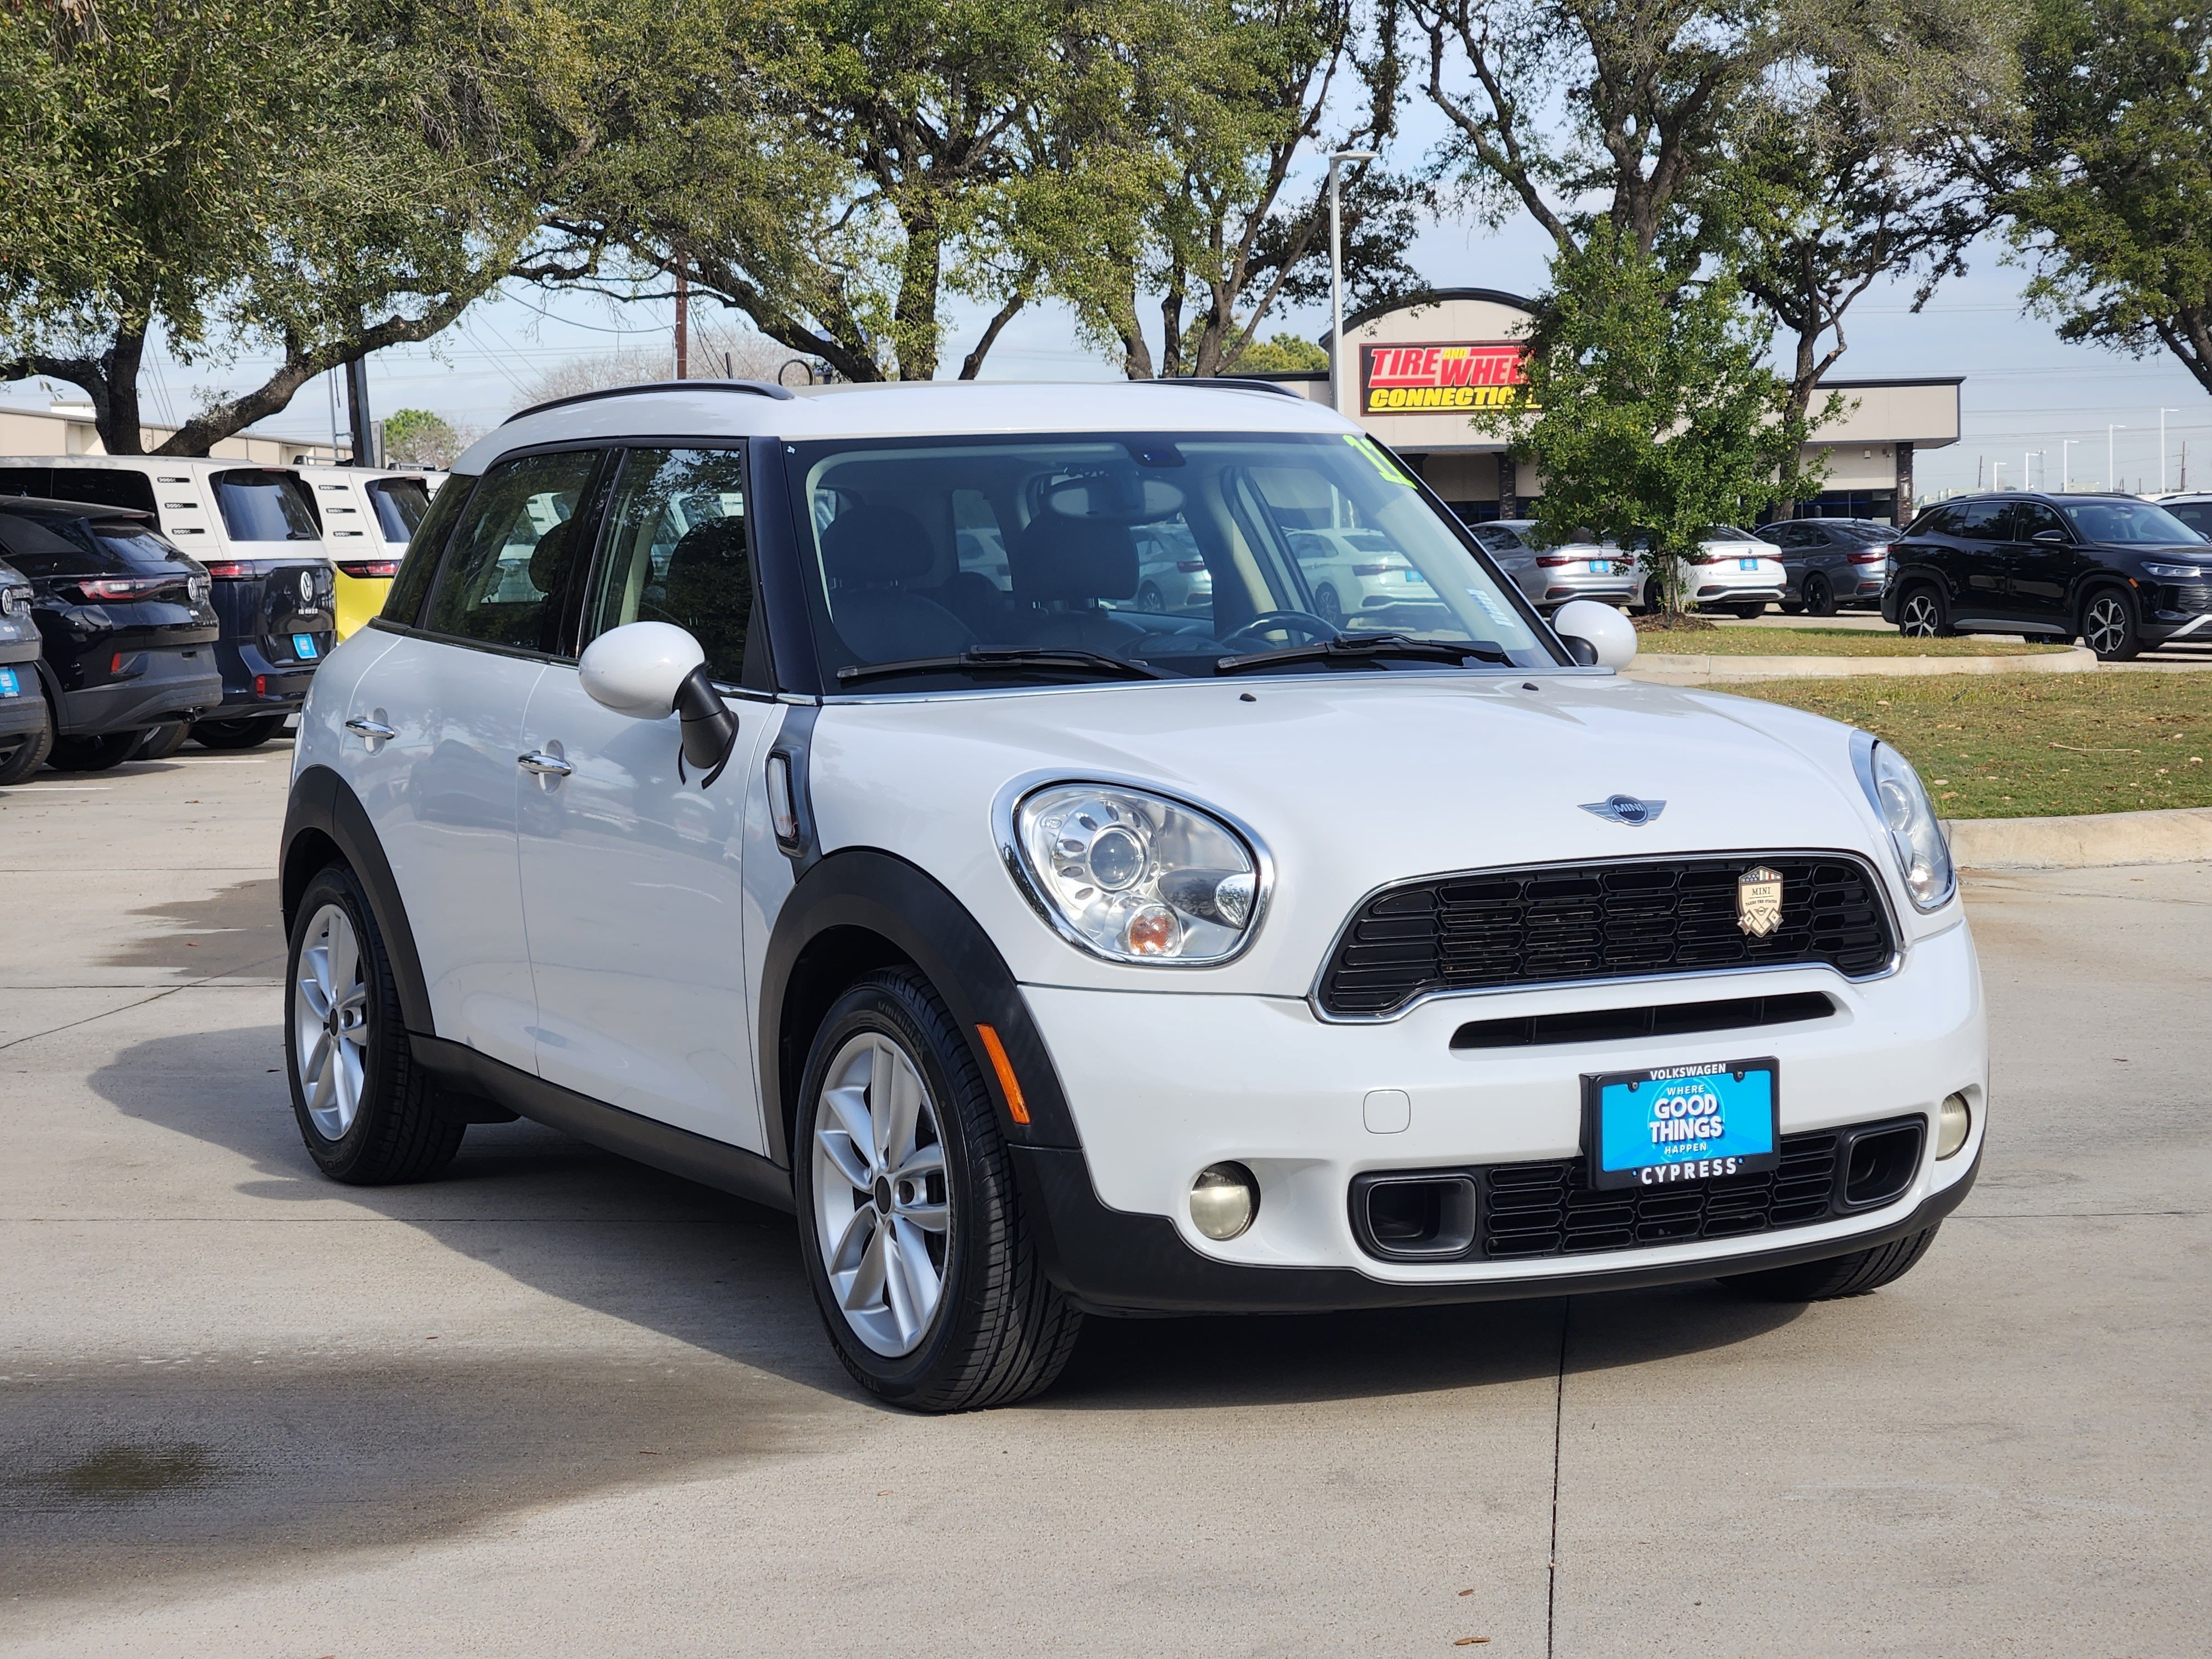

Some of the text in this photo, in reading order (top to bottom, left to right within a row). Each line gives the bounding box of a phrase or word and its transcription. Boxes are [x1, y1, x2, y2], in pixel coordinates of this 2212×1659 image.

[1371, 348, 1441, 375] TIRE
[1442, 347, 1468, 359] AND
[1440, 357, 1531, 385] WHEE
[1369, 387, 1533, 408] CONNECTIO
[1613, 803, 1645, 813] MINI
[1752, 886, 1771, 895] MINI
[1650, 1063, 1726, 1081] VOLKSWAGEN
[1667, 1084, 1705, 1096] WHERE
[1654, 1093, 1718, 1119] GOOD
[1649, 1115, 1723, 1143] THINGS
[1664, 1142, 1708, 1155] HAPPEN
[1641, 1157, 1737, 1185] CYPRESS
